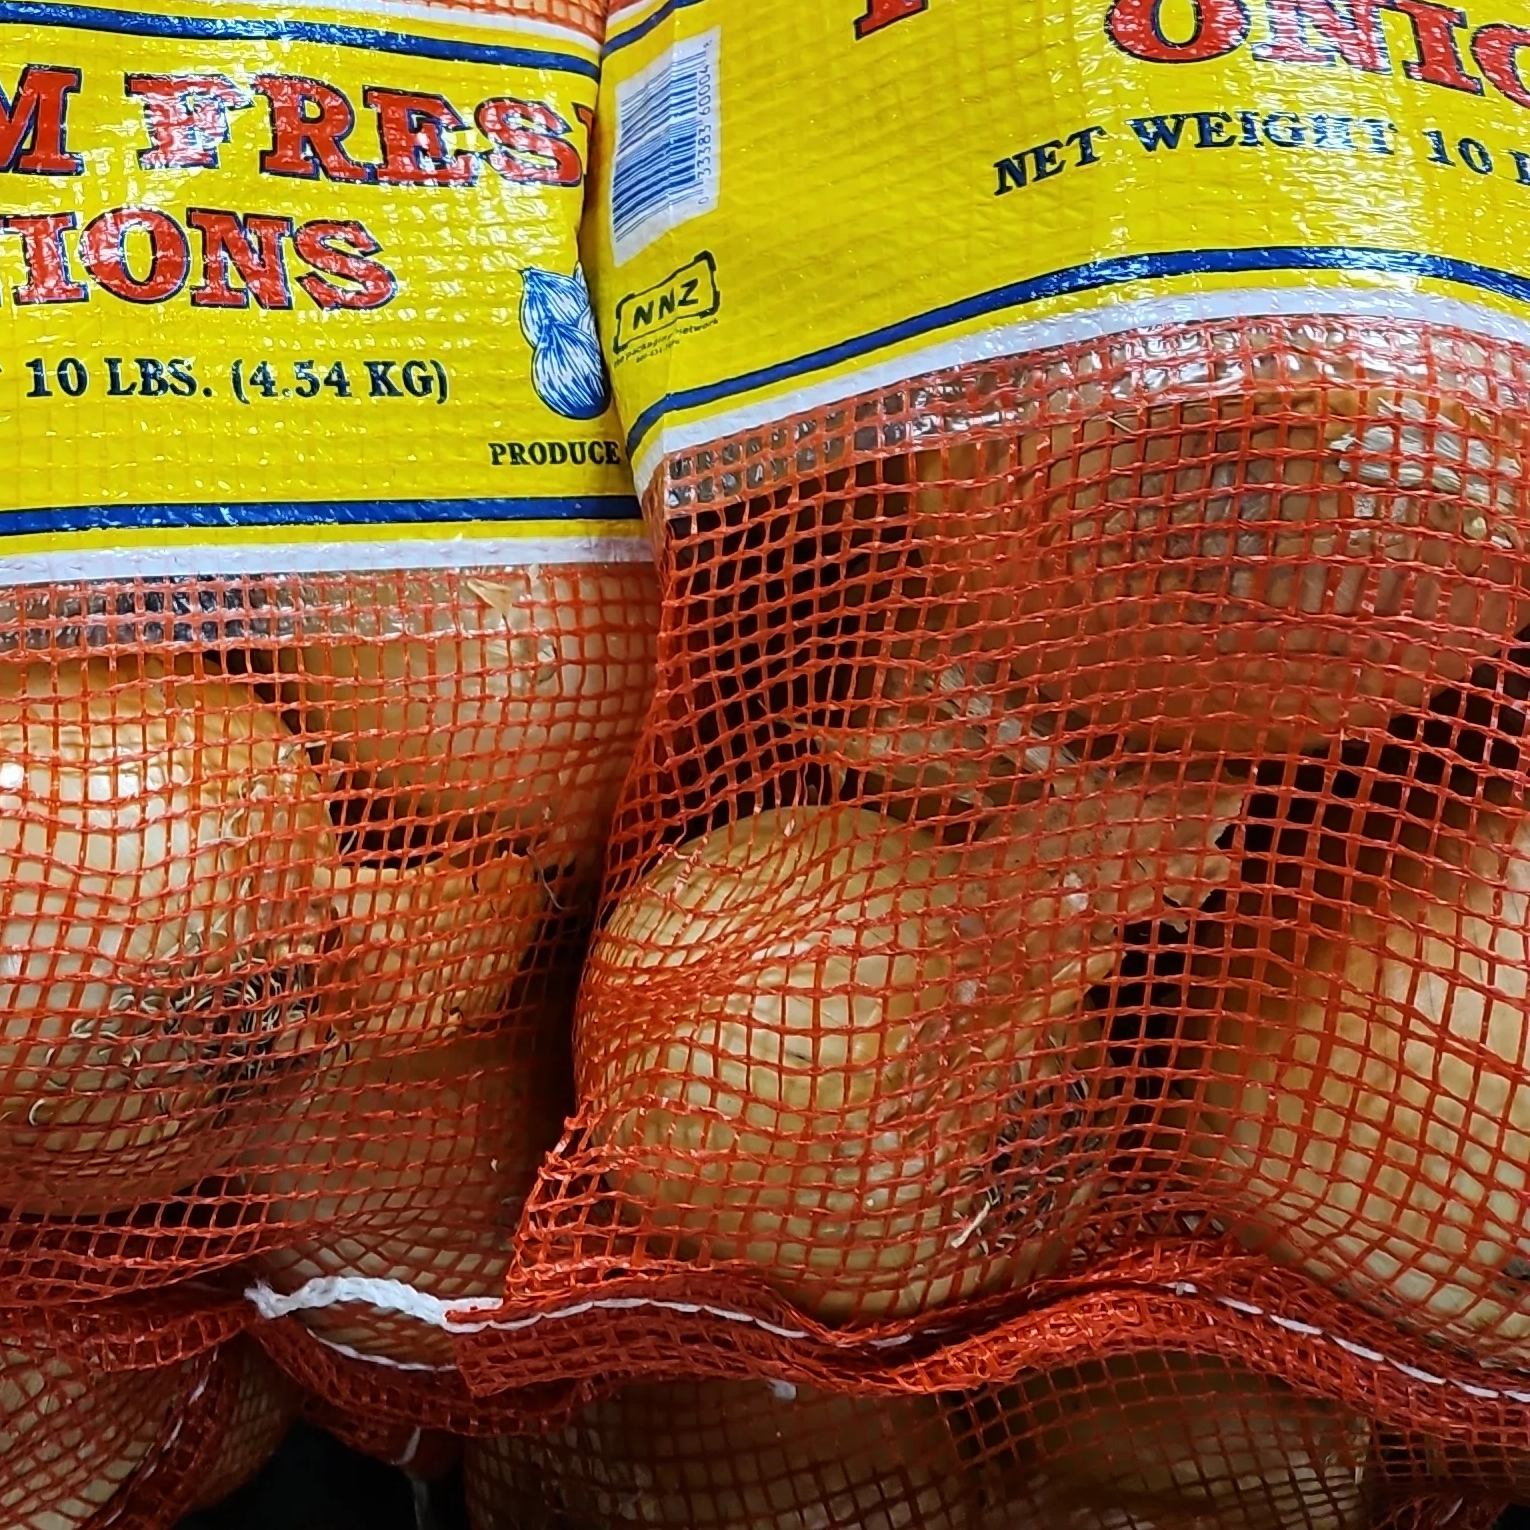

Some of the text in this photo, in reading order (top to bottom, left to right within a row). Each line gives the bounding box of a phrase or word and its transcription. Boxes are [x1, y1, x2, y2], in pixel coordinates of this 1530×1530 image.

[124, 71, 594, 188] FRES
[993, 126, 1107, 197] NET
[1125, 110, 1399, 156] WEIGHT
[1421, 126, 1495, 177] 10
[632, 278, 698, 330] NNZ
[25, 356, 89, 399] 10
[106, 356, 214, 398] LBS.
[232, 358, 356, 406] (4.54
[368, 359, 450, 406] KG)
[487, 441, 622, 466] PRODUCE
